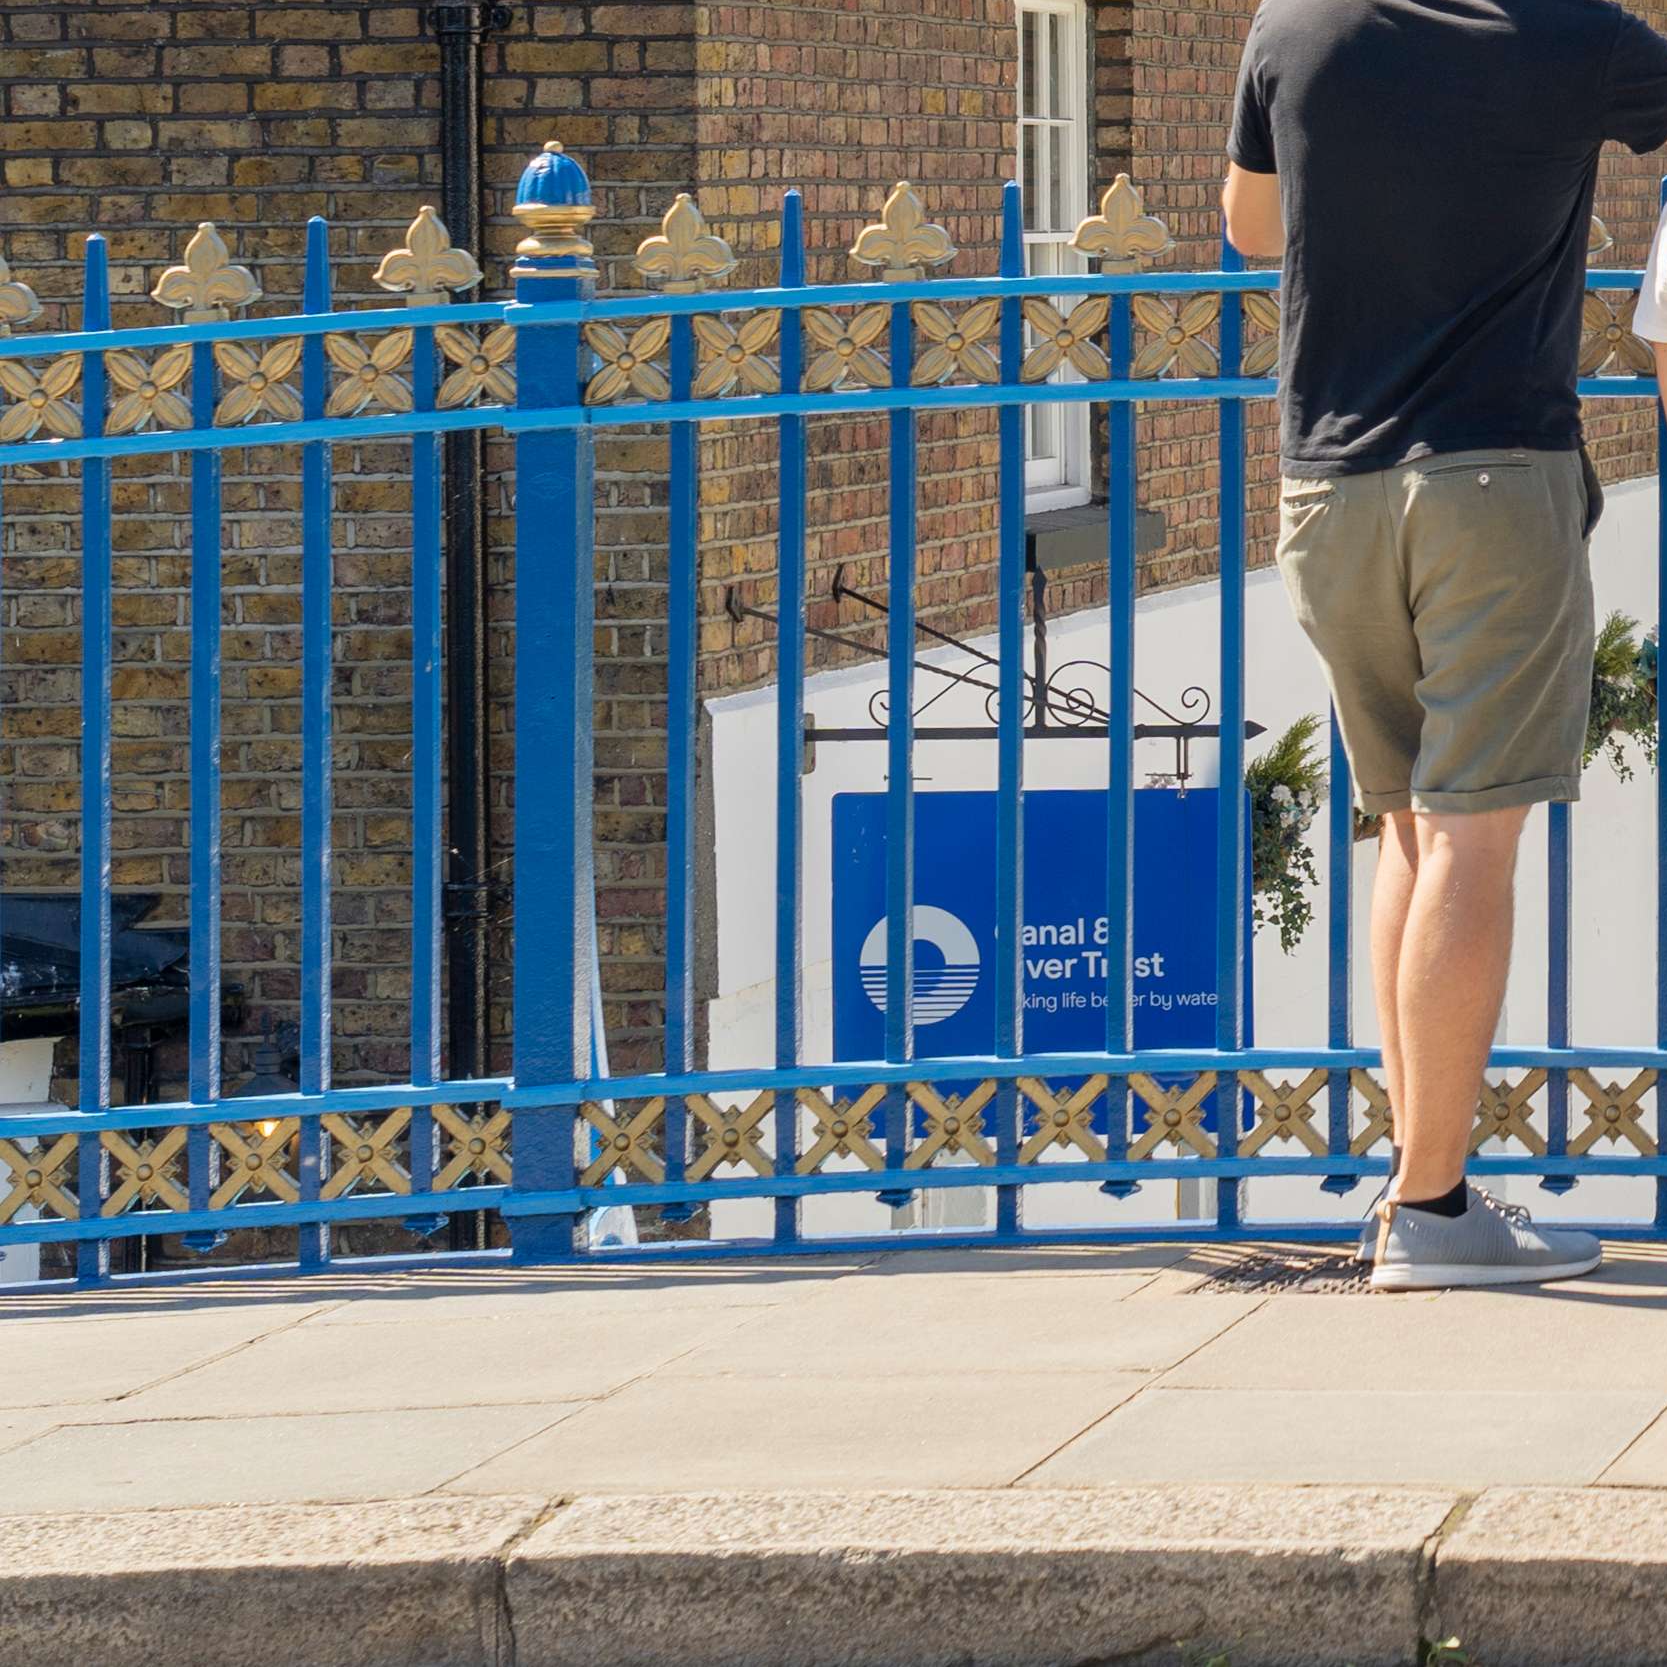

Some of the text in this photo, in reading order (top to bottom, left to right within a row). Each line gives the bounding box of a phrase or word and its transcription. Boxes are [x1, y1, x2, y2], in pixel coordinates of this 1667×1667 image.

[995, 917, 1108, 946] anal &
[1025, 951, 1165, 979] ver Trst
[1023, 990, 1218, 1013] king life beer by wate
